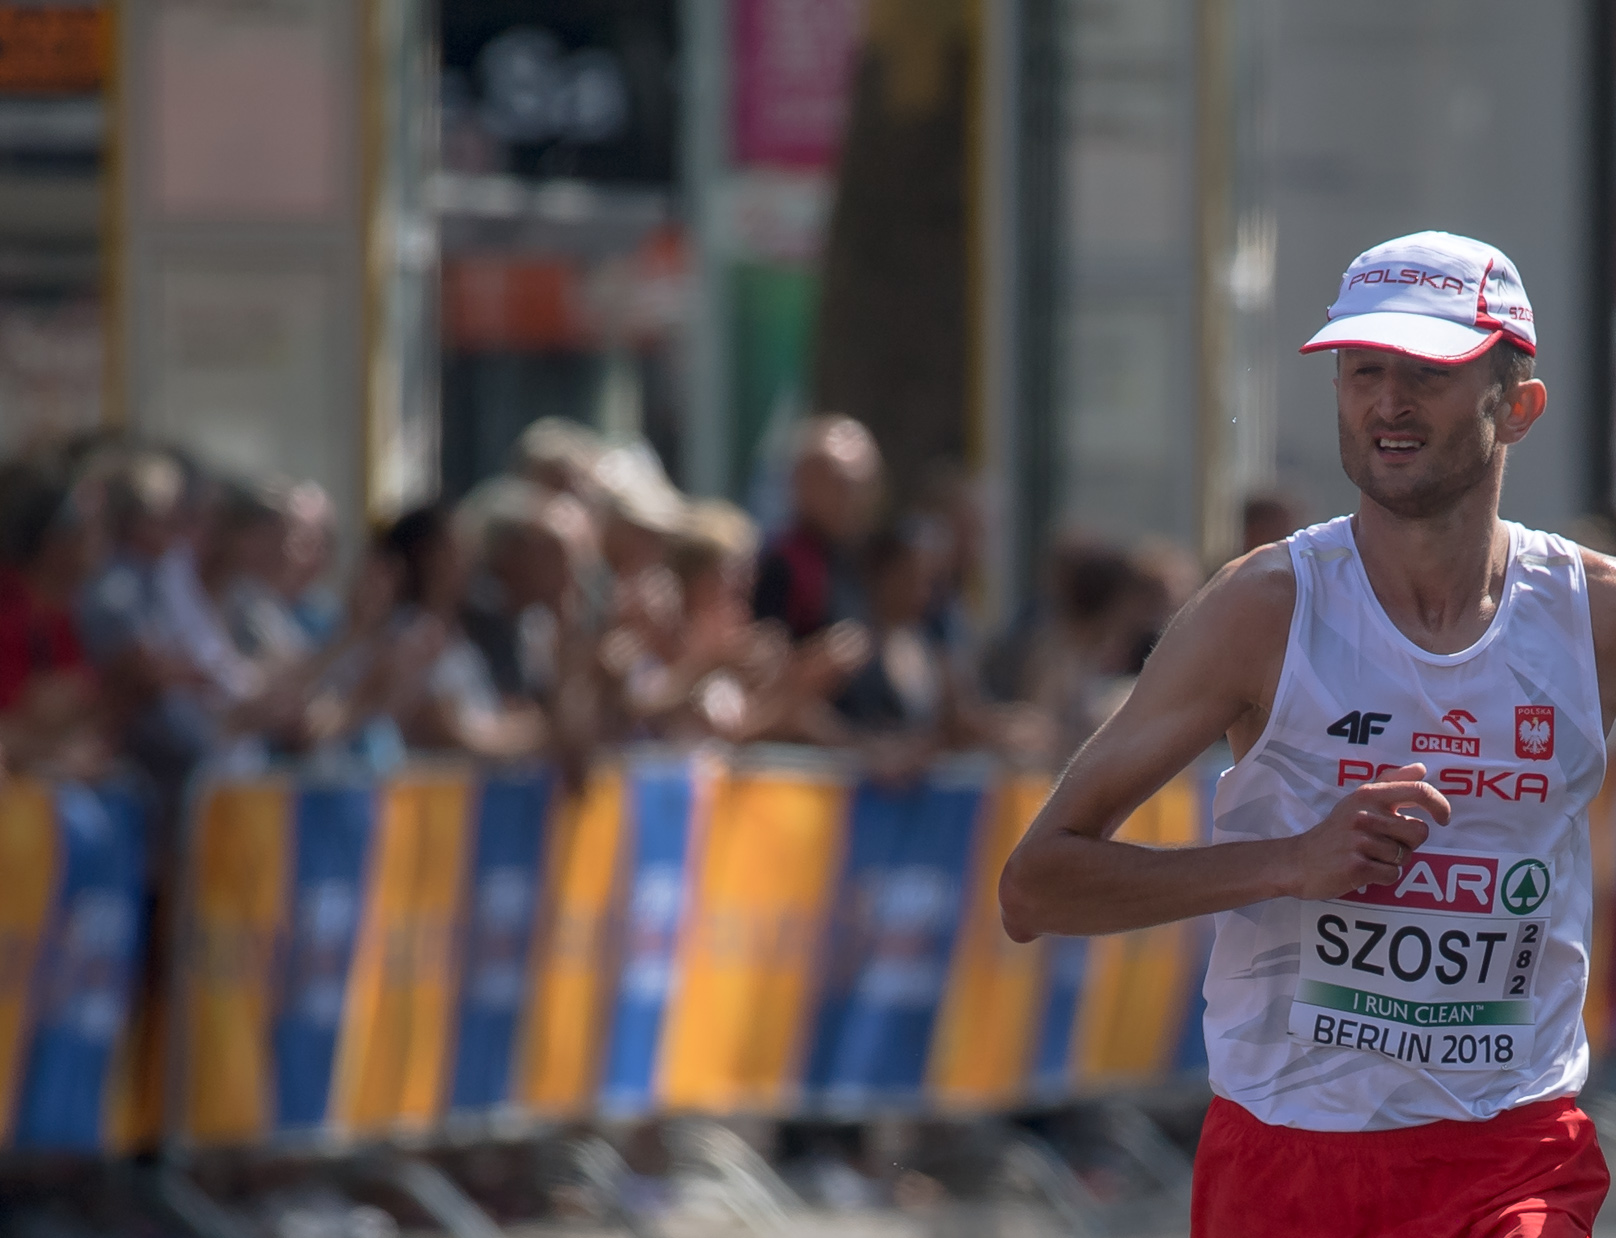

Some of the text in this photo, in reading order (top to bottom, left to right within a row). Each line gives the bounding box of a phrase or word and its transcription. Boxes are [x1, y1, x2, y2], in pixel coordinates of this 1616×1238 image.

[1348, 268, 1464, 295] POLSKA
[1326, 710, 1393, 745] 4F
[1517, 707, 1553, 717] POLSKA
[1414, 735, 1476, 754] ORLEN
[1337, 758, 1549, 804] PSKA
[1357, 860, 1492, 906] AR
[1315, 913, 1508, 986] SZOST
[1509, 923, 1539, 995] 282
[1353, 992, 1360, 1010] I
[1365, 995, 1409, 1021] RUN
[1313, 1013, 1514, 1064] BERLIN 2018
